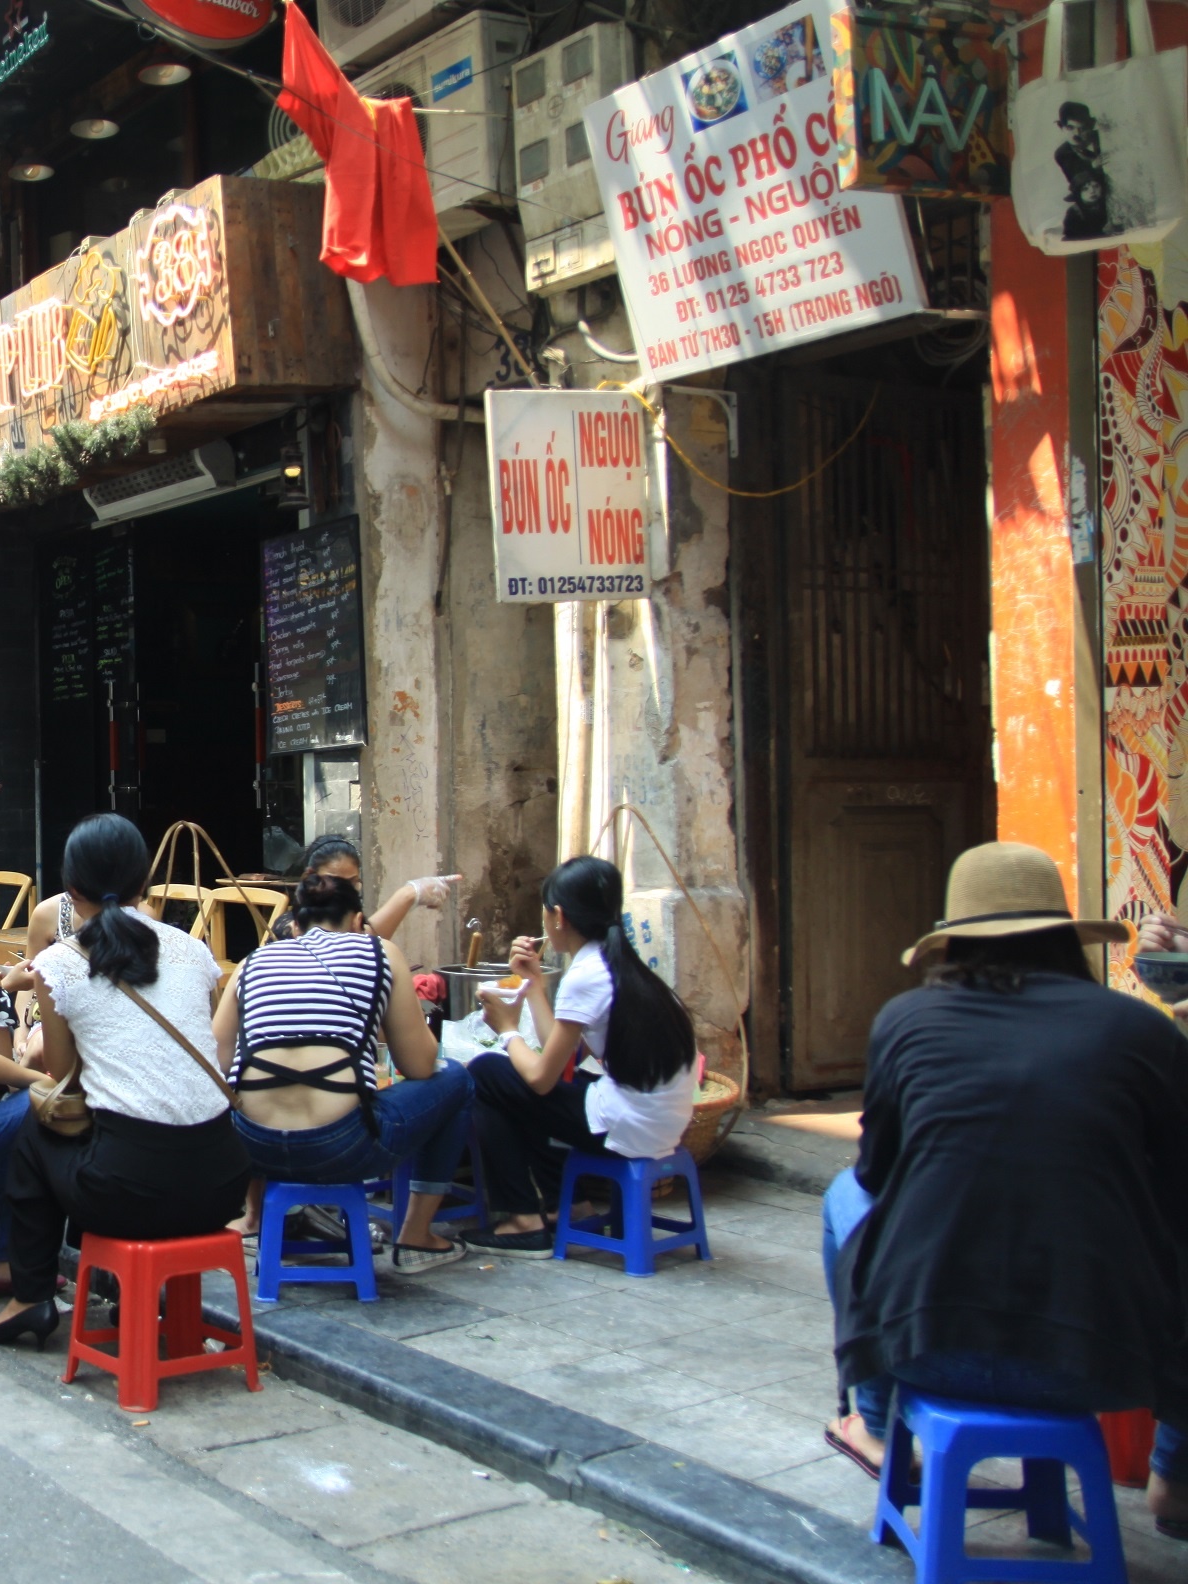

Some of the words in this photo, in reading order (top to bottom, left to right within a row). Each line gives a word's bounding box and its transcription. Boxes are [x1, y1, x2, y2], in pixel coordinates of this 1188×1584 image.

[433, 67, 471, 91] sumikura
[605, 105, 674, 164] Giang
[616, 172, 679, 231] BÚN
[683, 142, 726, 204] ỐC
[728, 103, 797, 188] PHỐ
[153, 230, 196, 302] 38
[644, 208, 724, 260] NÓNG
[648, 271, 670, 296] 36
[673, 250, 732, 288] LƯƠNG
[734, 231, 788, 264] NGỌC
[792, 203, 862, 250] QUYẾN
[646, 341, 678, 370] BÁN
[679, 328, 700, 360] TỪ
[701, 324, 741, 354] 7H30
[754, 310, 786, 339] 15H
[790, 289, 853, 332] (TRONG
[854, 271, 903, 308] NGÕ)
[676, 298, 702, 323] ĐT:
[705, 281, 750, 314] 0125
[755, 264, 801, 298] 4733
[808, 251, 845, 283] 723
[578, 400, 642, 480] NGUỘI
[499, 442, 542, 535] BÚN
[545, 431, 572, 534] ỐC
[587, 496, 645, 565] NÓNG
[507, 577, 533, 596] ĐT:
[538, 575, 644, 595] 01254733723
